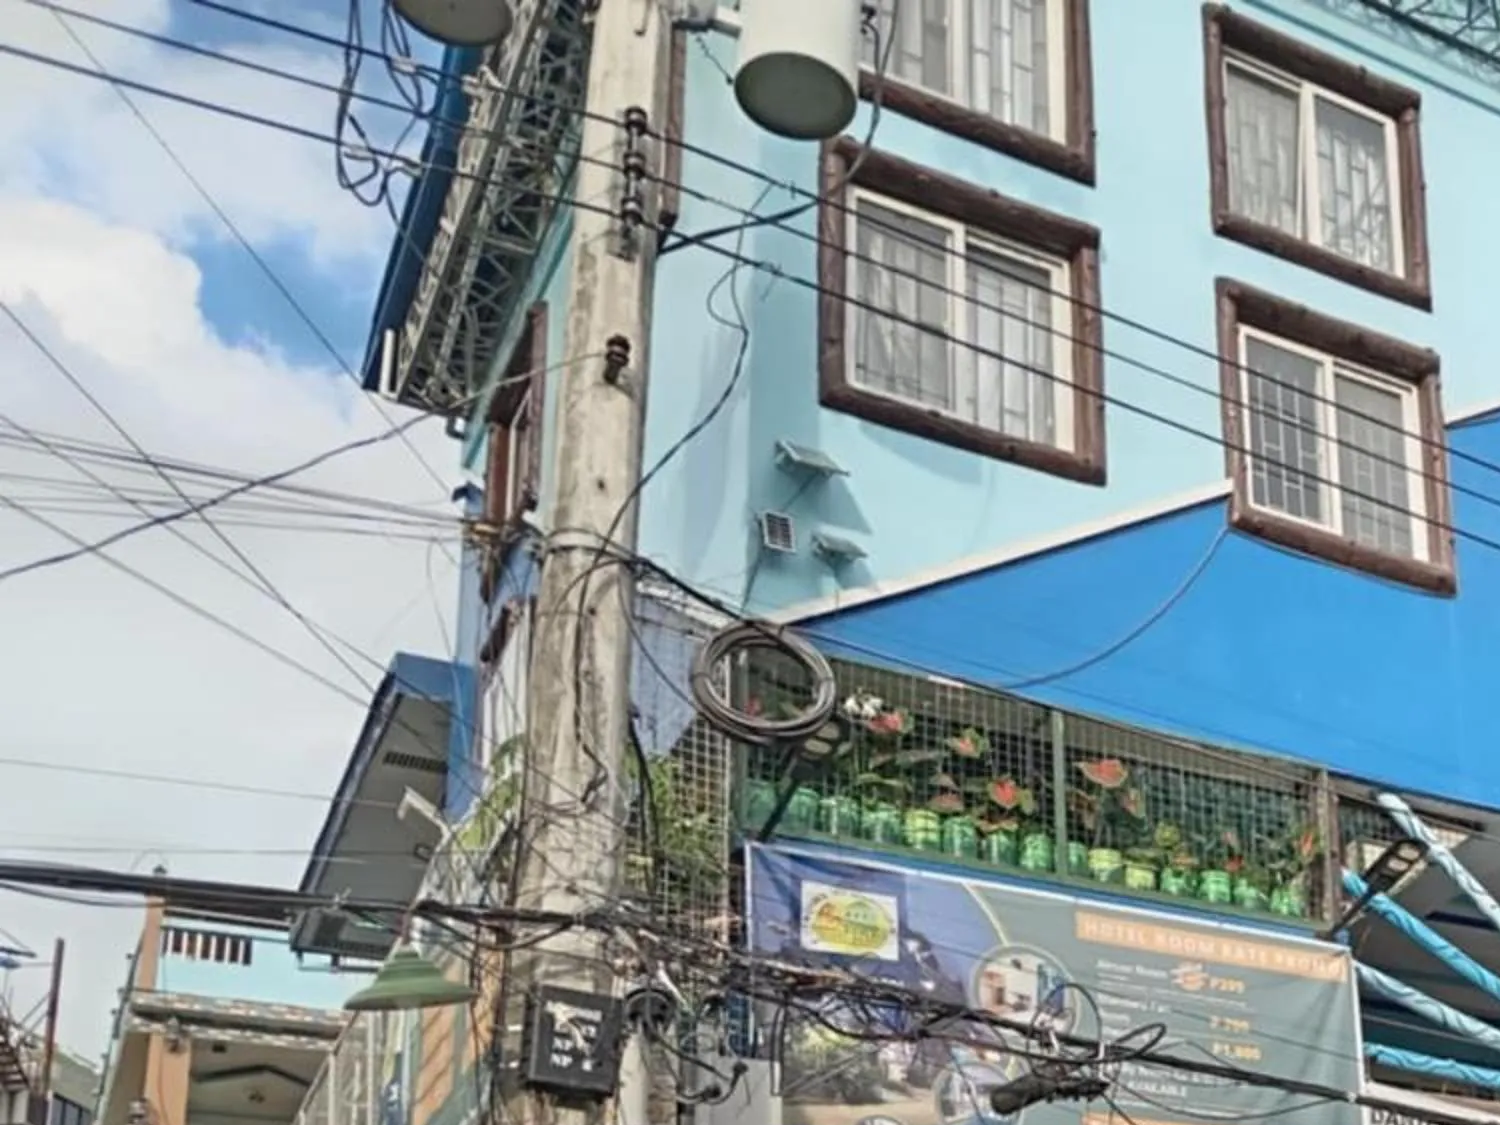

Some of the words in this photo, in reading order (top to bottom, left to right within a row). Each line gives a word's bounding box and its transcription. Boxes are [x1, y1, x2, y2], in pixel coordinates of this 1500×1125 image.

[1085, 918, 1146, 944] HOTEL
[1156, 929, 1215, 957] ROOM
[1222, 944, 1268, 964] RATE
